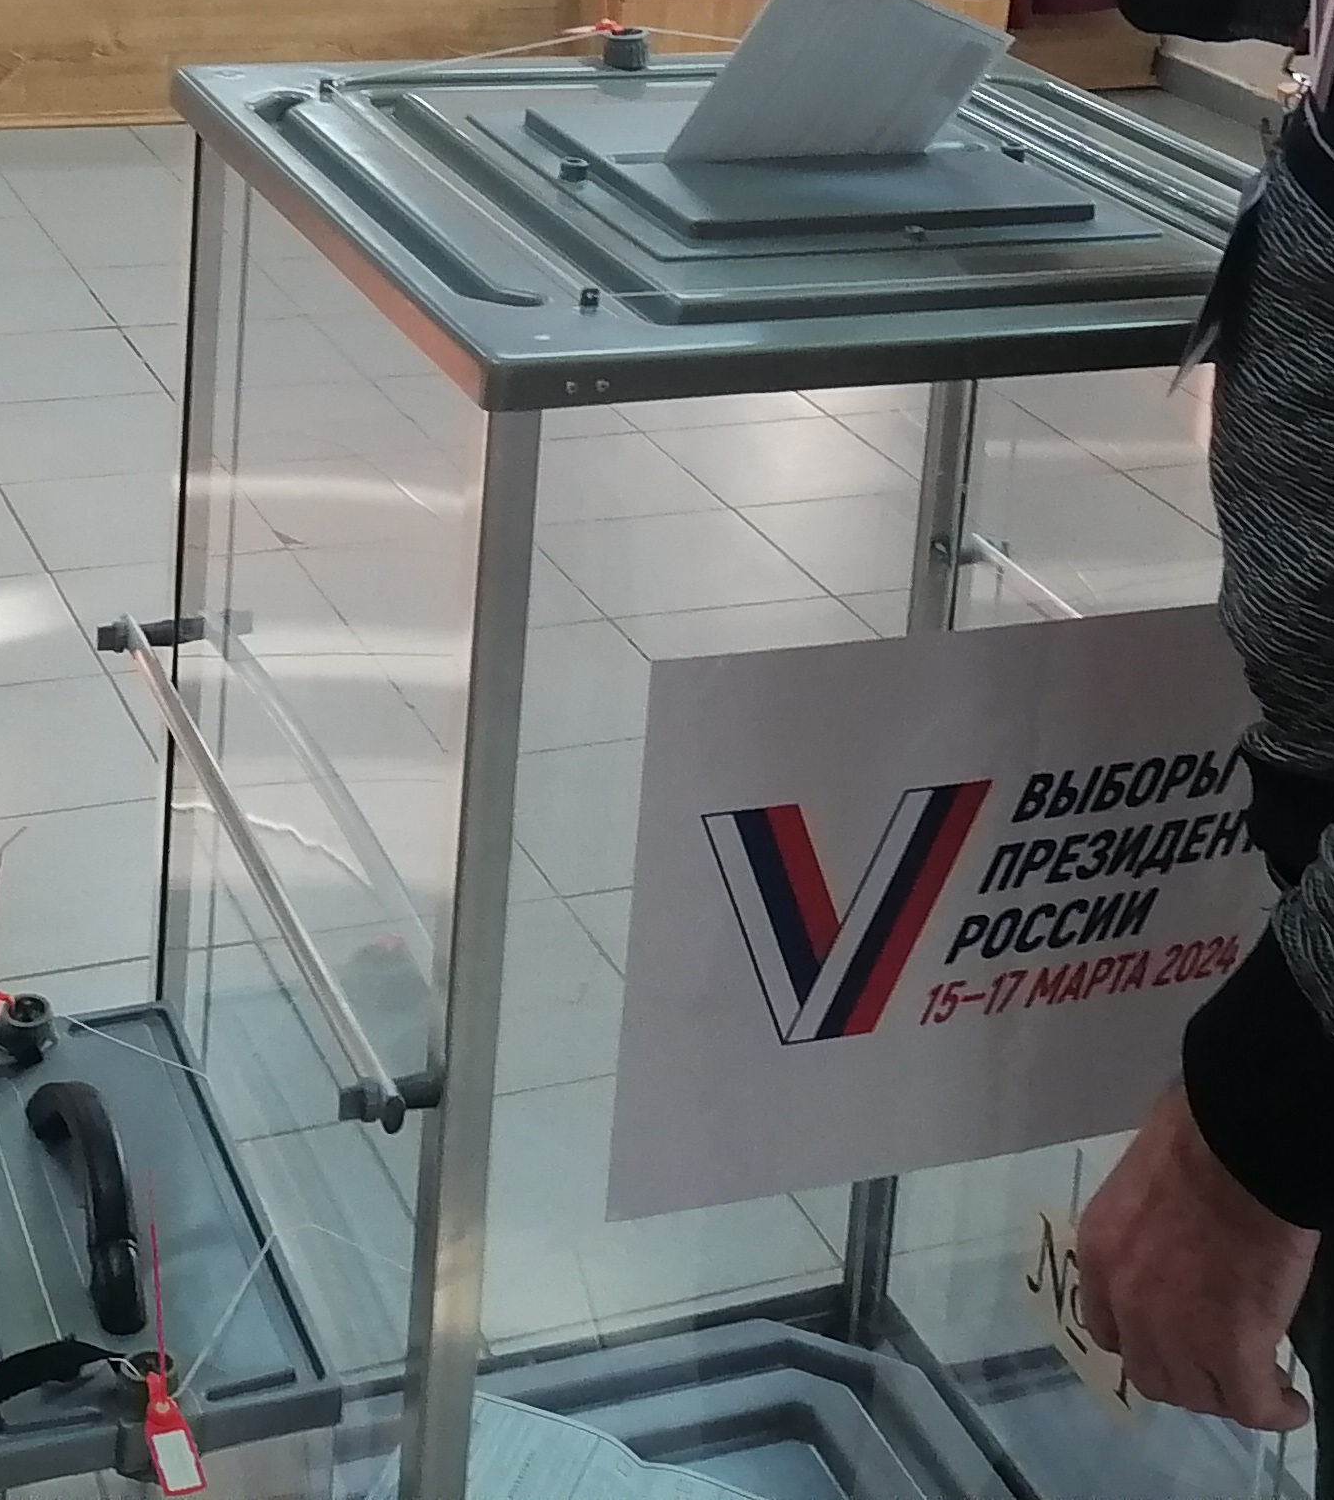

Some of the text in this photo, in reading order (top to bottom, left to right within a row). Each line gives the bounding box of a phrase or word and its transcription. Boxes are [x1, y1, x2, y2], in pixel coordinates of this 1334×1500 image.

[1012, 750, 1241, 823] ВЫБОРЫ
[979, 809, 1255, 895] ПРЕЗИДЕН
[944, 887, 1159, 965] РОССИИ
[1025, 951, 1151, 1008] МАРТА
[1153, 935, 1240, 986] 2024
